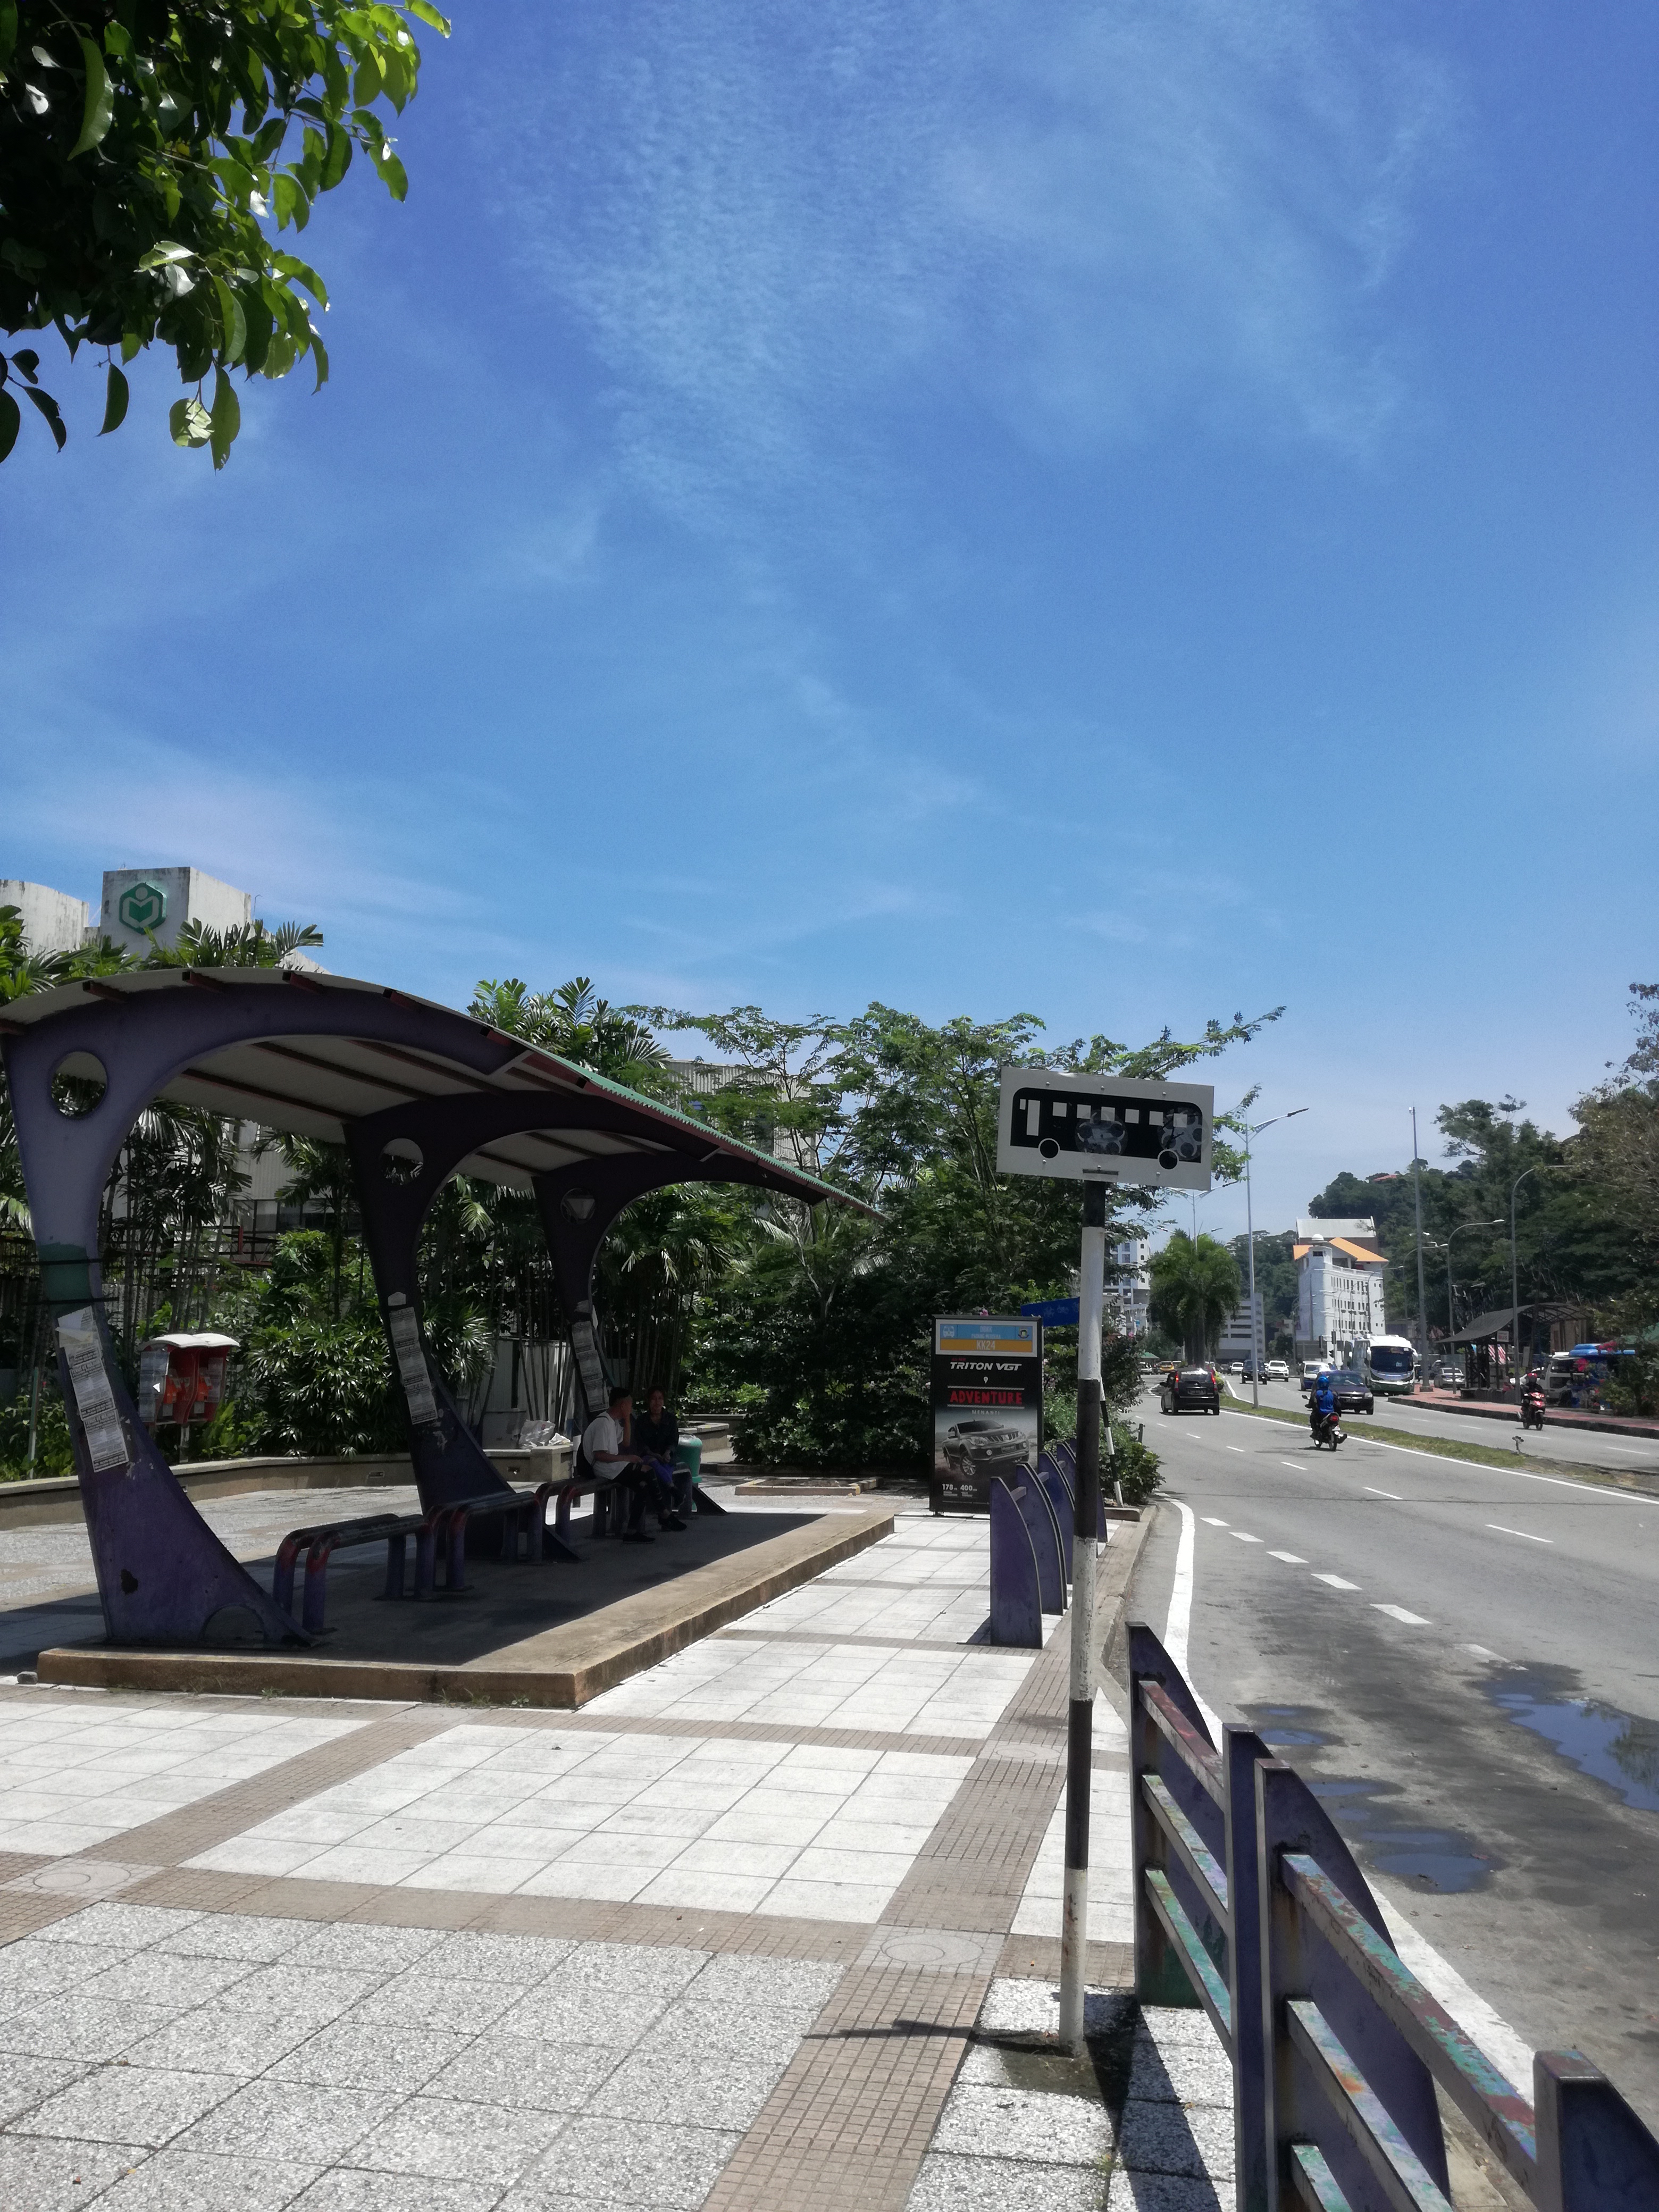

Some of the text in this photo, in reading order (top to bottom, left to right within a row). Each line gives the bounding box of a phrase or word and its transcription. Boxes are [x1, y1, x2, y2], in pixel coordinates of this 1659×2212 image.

[976, 1340, 996, 1350] KK24
[950, 1362, 994, 1370] TRITON
[950, 1390, 1023, 1405] ADVENTURE
